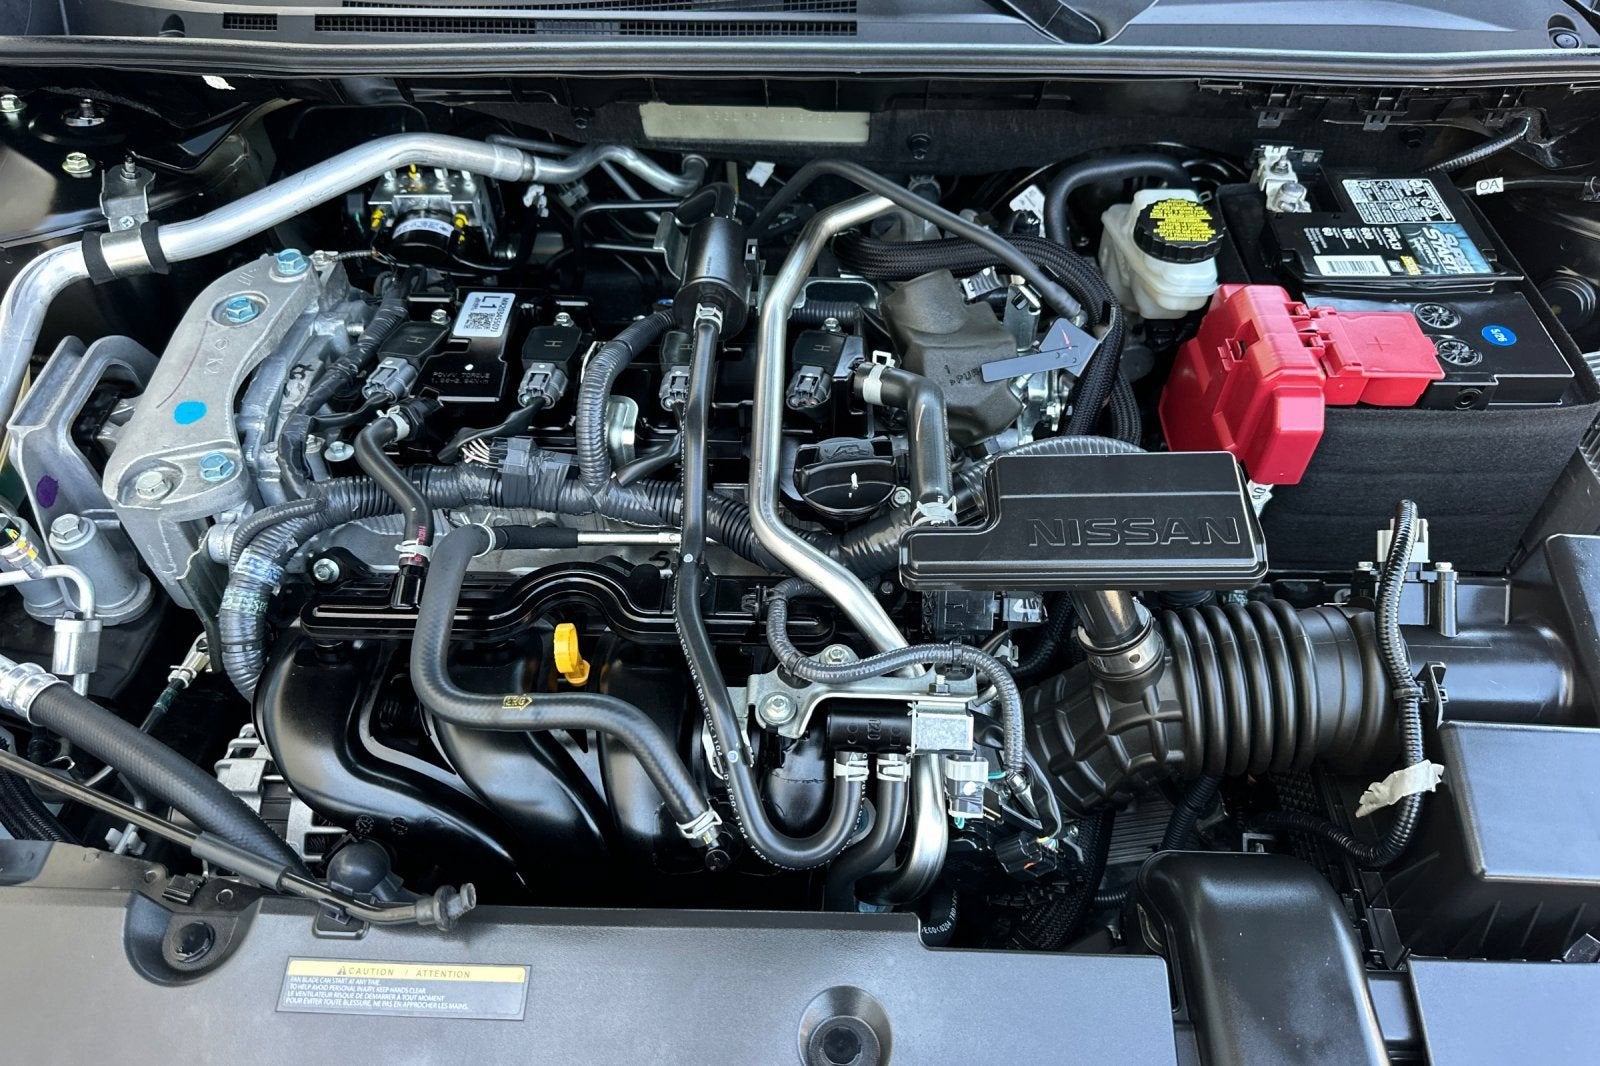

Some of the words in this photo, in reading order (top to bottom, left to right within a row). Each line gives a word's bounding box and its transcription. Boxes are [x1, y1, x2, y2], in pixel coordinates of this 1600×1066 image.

[1422, 227, 1461, 273] START
[1439, 233, 1476, 274] SUPER
[480, 296, 500, 308] L1
[1027, 517, 1240, 546] NISSAN
[348, 967, 394, 976] CAUTION
[416, 969, 471, 978] ATTENTION
[403, 1001, 437, 1009] APPROCHER
